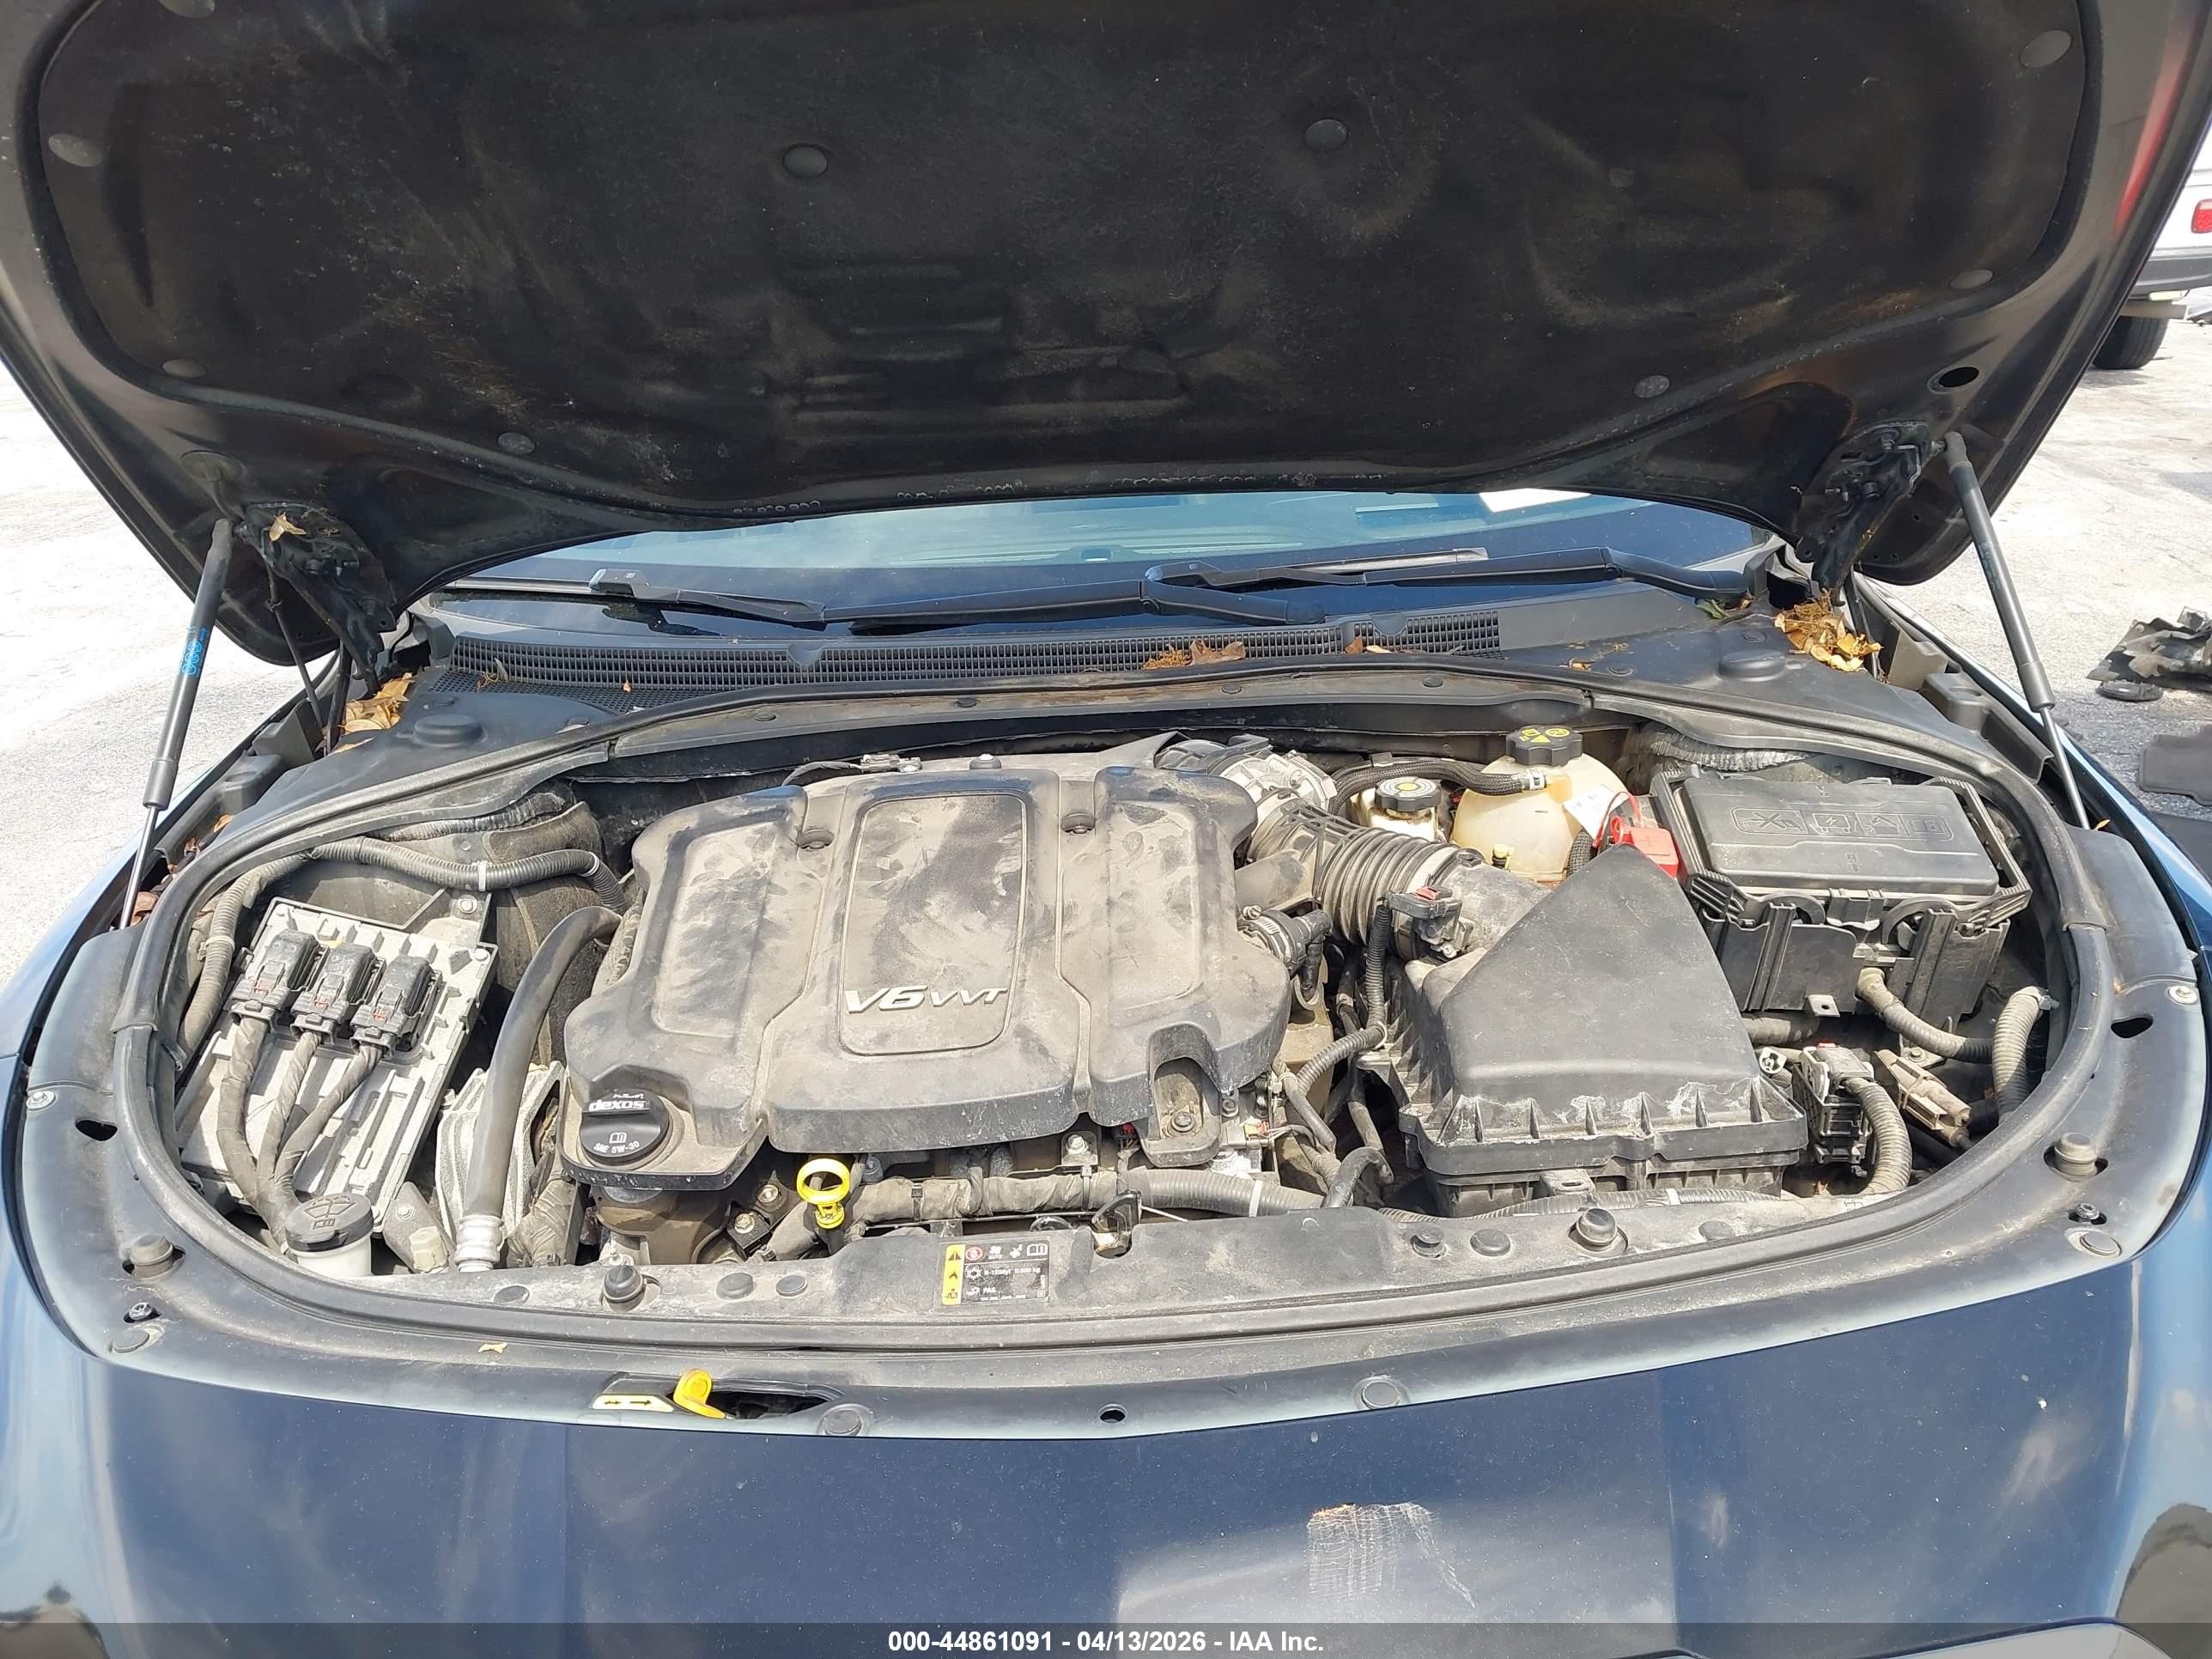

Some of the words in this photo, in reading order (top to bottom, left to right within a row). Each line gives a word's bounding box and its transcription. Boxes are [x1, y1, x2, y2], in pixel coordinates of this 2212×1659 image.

[844, 985, 928, 1014] V6
[930, 988, 1008, 1008] VVT
[593, 1143, 609, 1153] SAE
[611, 1141, 640, 1153] 5W-30
